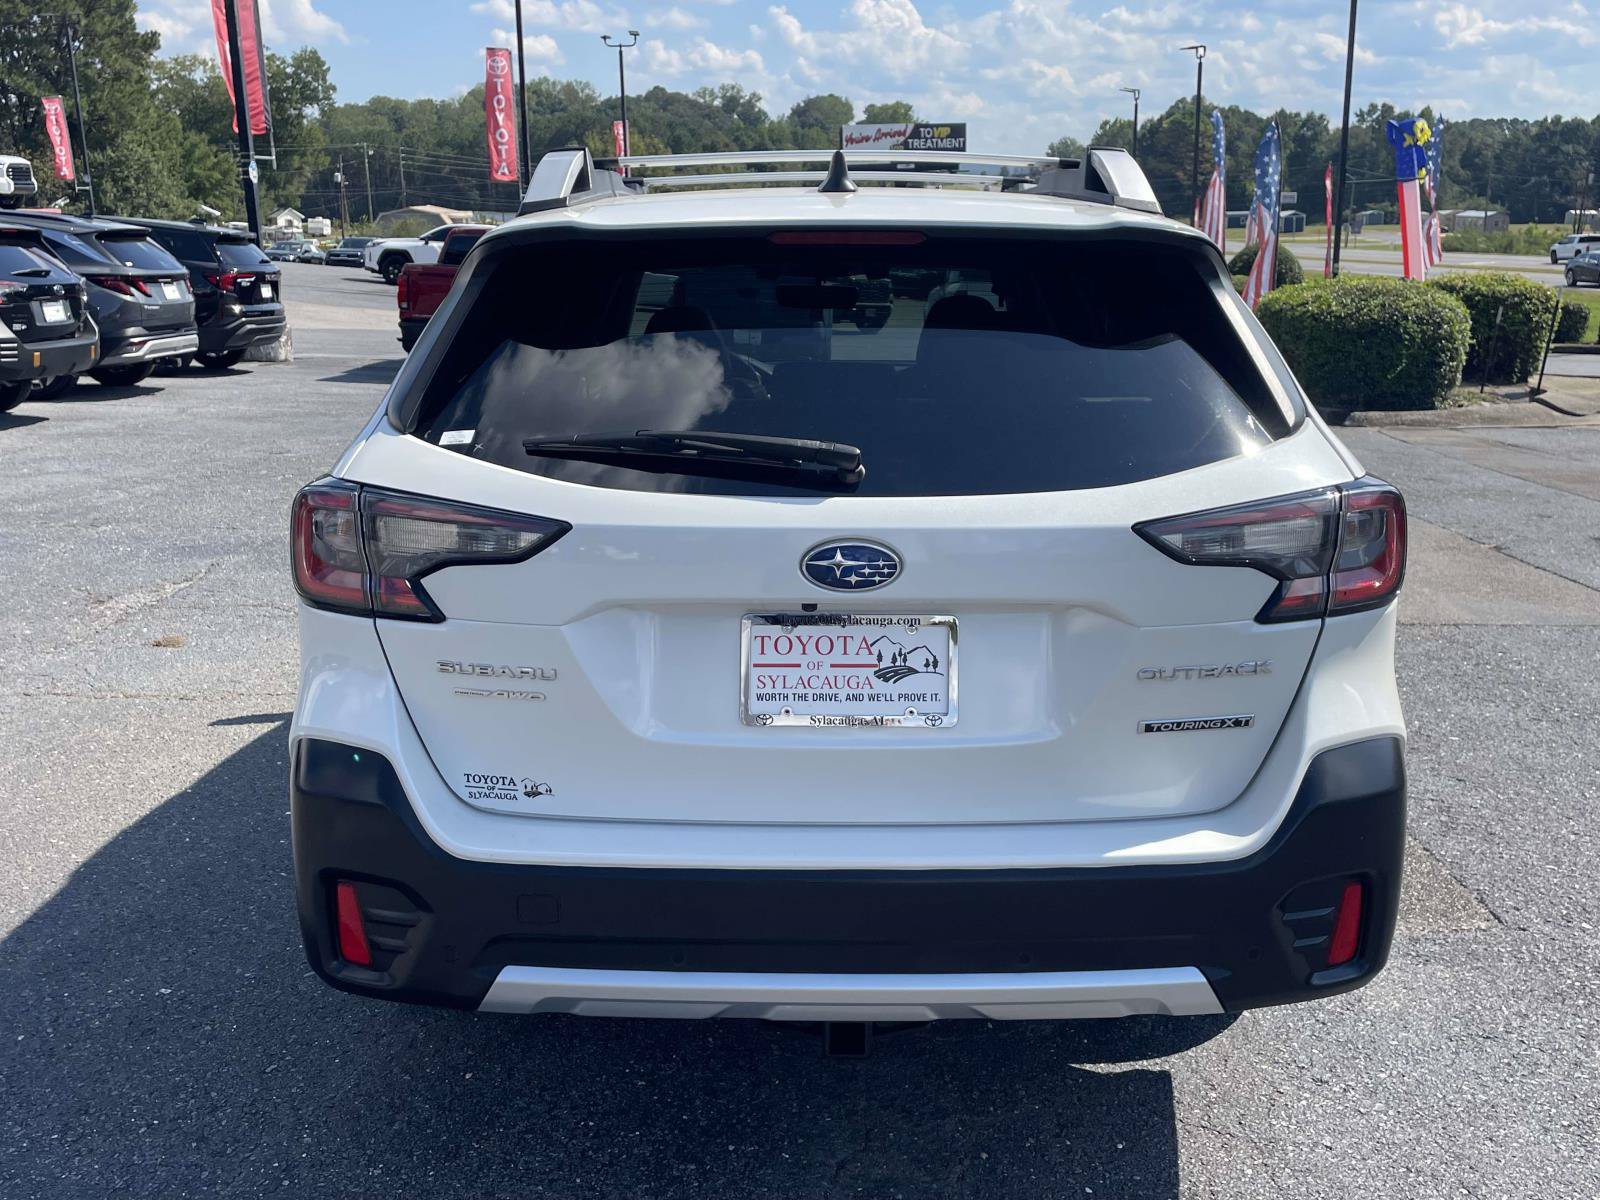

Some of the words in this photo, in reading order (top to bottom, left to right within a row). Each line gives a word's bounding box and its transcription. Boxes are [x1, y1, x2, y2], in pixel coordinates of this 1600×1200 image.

[493, 78, 510, 176] TOYOTA
[920, 127, 933, 138] TO
[932, 126, 952, 138] VIP
[907, 137, 965, 149] TREATMENT
[754, 635, 874, 656] TOYOTA
[436, 659, 558, 681] SUBARU
[806, 660, 824, 671] OF
[1136, 658, 1273, 681] OUTBACK
[756, 674, 875, 690] SYLACAUGA
[488, 689, 547, 701] AWD
[756, 692, 789, 702] WORTH
[792, 692, 809, 702] THE
[812, 692, 842, 704] DRIVE,
[845, 692, 864, 702] AND
[867, 692, 895, 702] WE'LL
[897, 692, 928, 702] PROVE
[930, 692, 941, 702] IT.
[463, 772, 518, 787] TOYOTA
